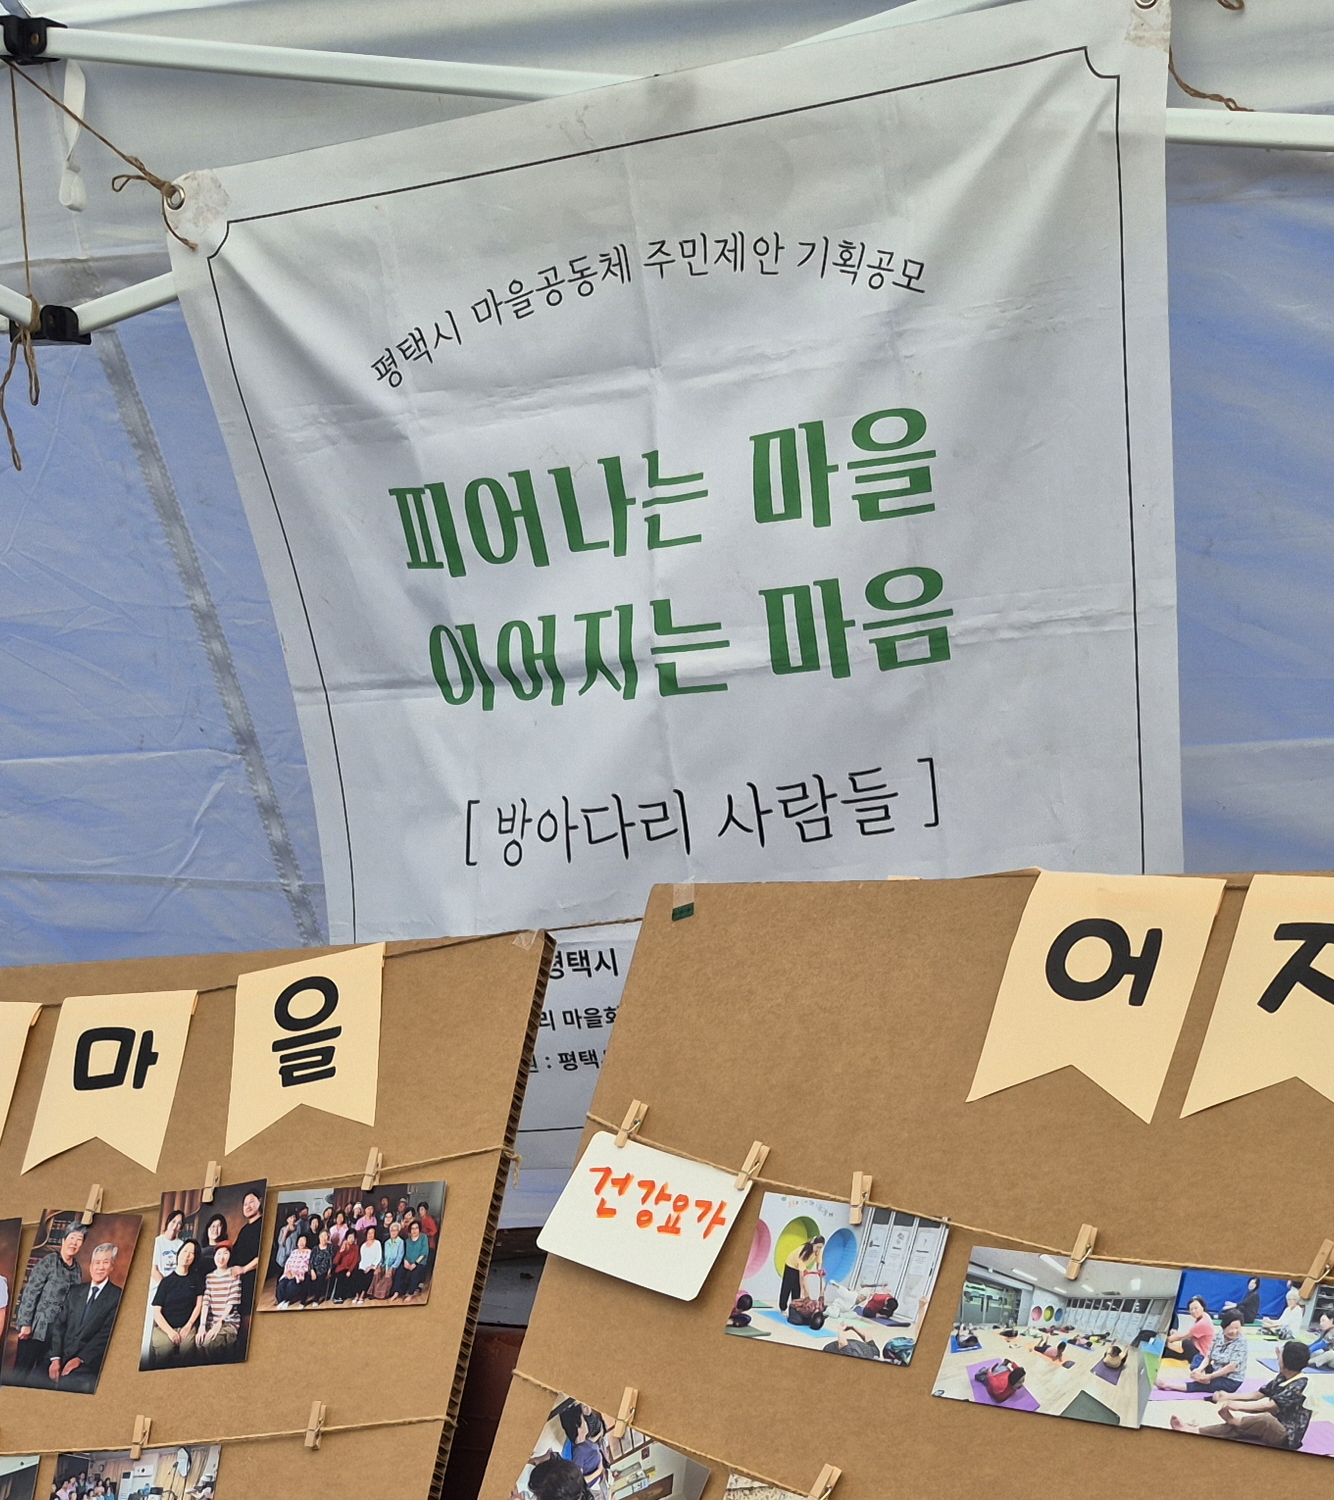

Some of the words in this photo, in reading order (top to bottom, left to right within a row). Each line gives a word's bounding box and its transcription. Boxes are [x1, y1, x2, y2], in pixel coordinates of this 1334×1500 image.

[370, 310, 463, 388] 평택시
[470, 243, 633, 326] 마을공동체
[643, 231, 786, 279] 주민제안
[797, 236, 927, 294] 기획공모
[389, 451, 710, 577] 피어나는
[750, 408, 938, 528] 마을
[428, 599, 730, 711] 이어지는
[759, 566, 955, 680] 마음
[557, 1049, 606, 1071] 평택
[589, 1166, 728, 1240] 건강요가
